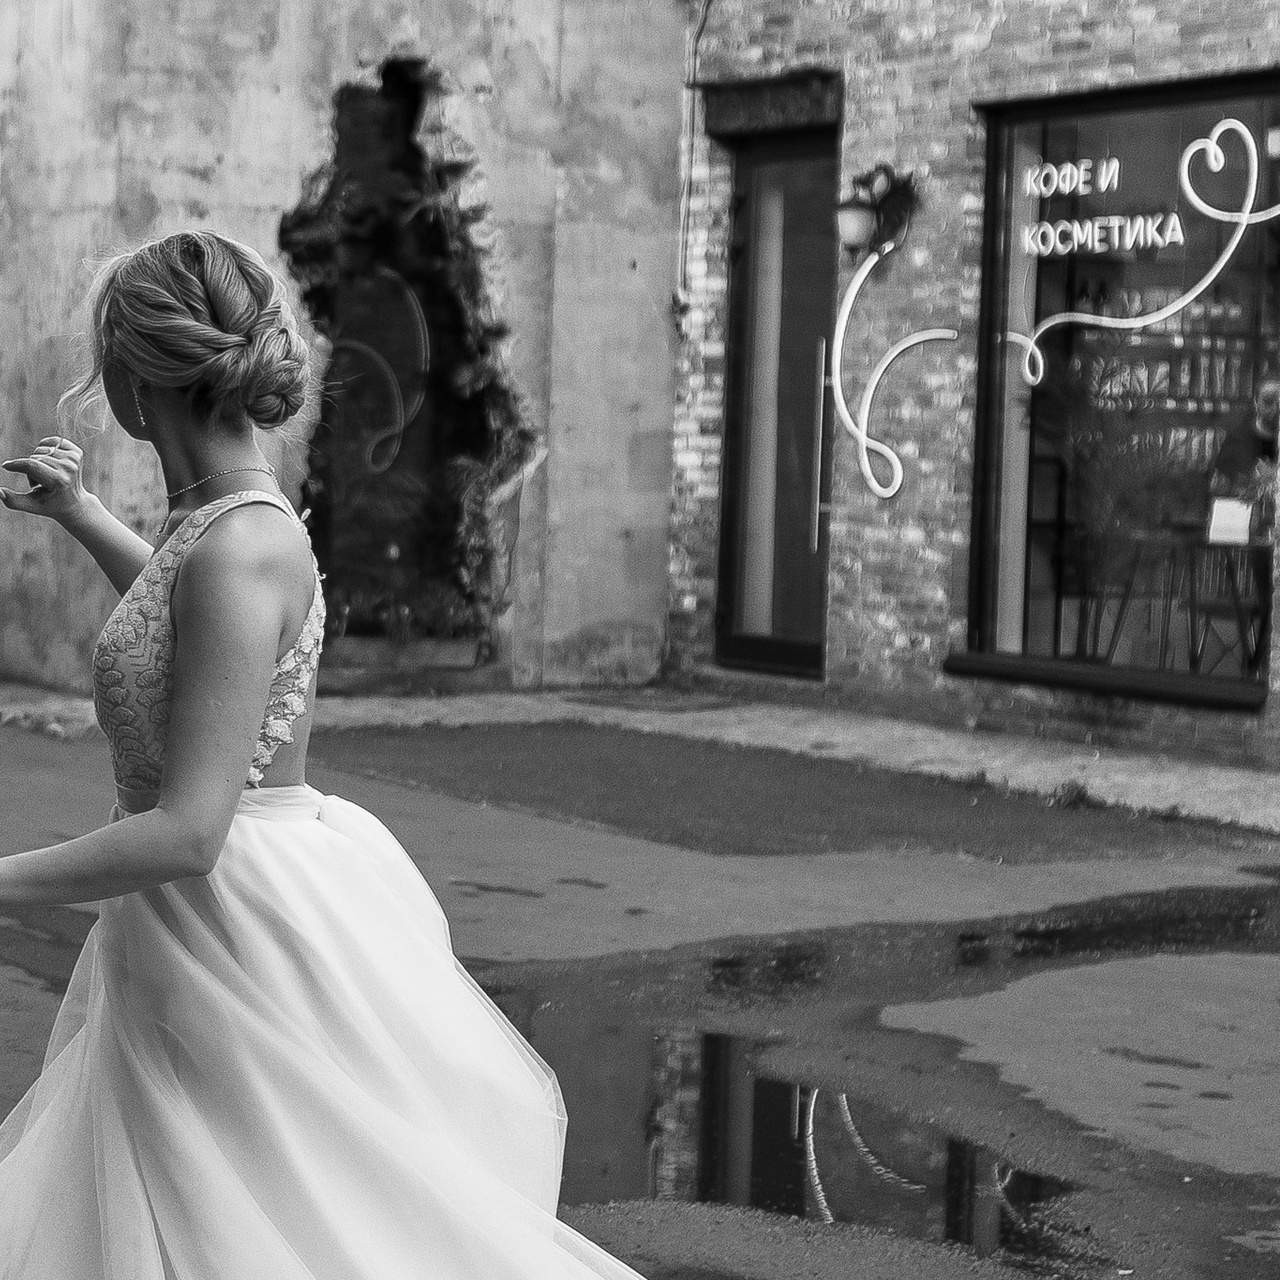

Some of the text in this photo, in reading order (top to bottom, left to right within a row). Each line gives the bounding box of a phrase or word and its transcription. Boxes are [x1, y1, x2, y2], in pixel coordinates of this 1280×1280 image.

[1024, 156, 1120, 198] КОФЕ И
[1023, 212, 1185, 257] КОСМЕТИКА
